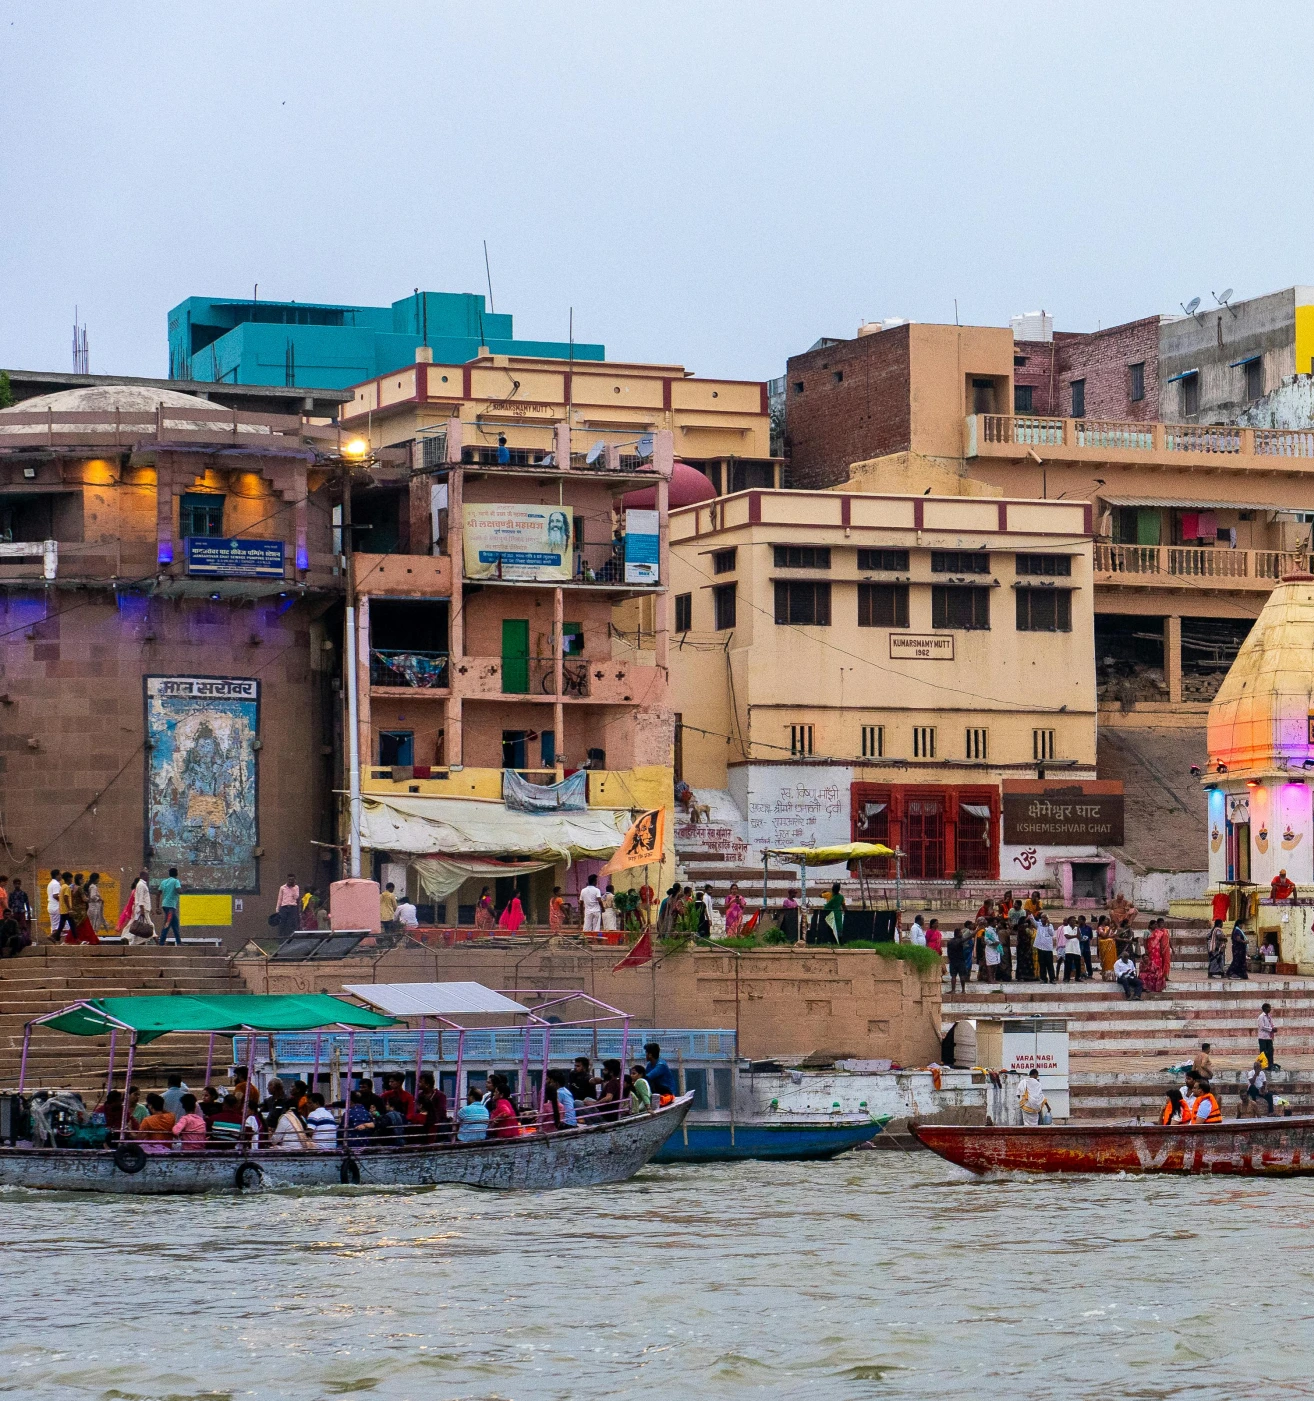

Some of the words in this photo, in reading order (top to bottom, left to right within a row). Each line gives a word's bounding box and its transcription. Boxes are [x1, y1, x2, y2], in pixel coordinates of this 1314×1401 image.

[532, 405, 548, 413] MUTT
[372, 484, 384, 500] YOGA
[384, 484, 402, 500] CENTRE
[467, 519, 477, 528] श्री
[934, 640, 950, 648] MUTT
[196, 680, 251, 694] सरोवर
[1028, 800, 1071, 820] क्षेमेश्वर
[1076, 806, 1101, 818] घाट
[1017, 824, 1086, 832] KSHEMESHVAR
[1088, 824, 1111, 832] GHAT
